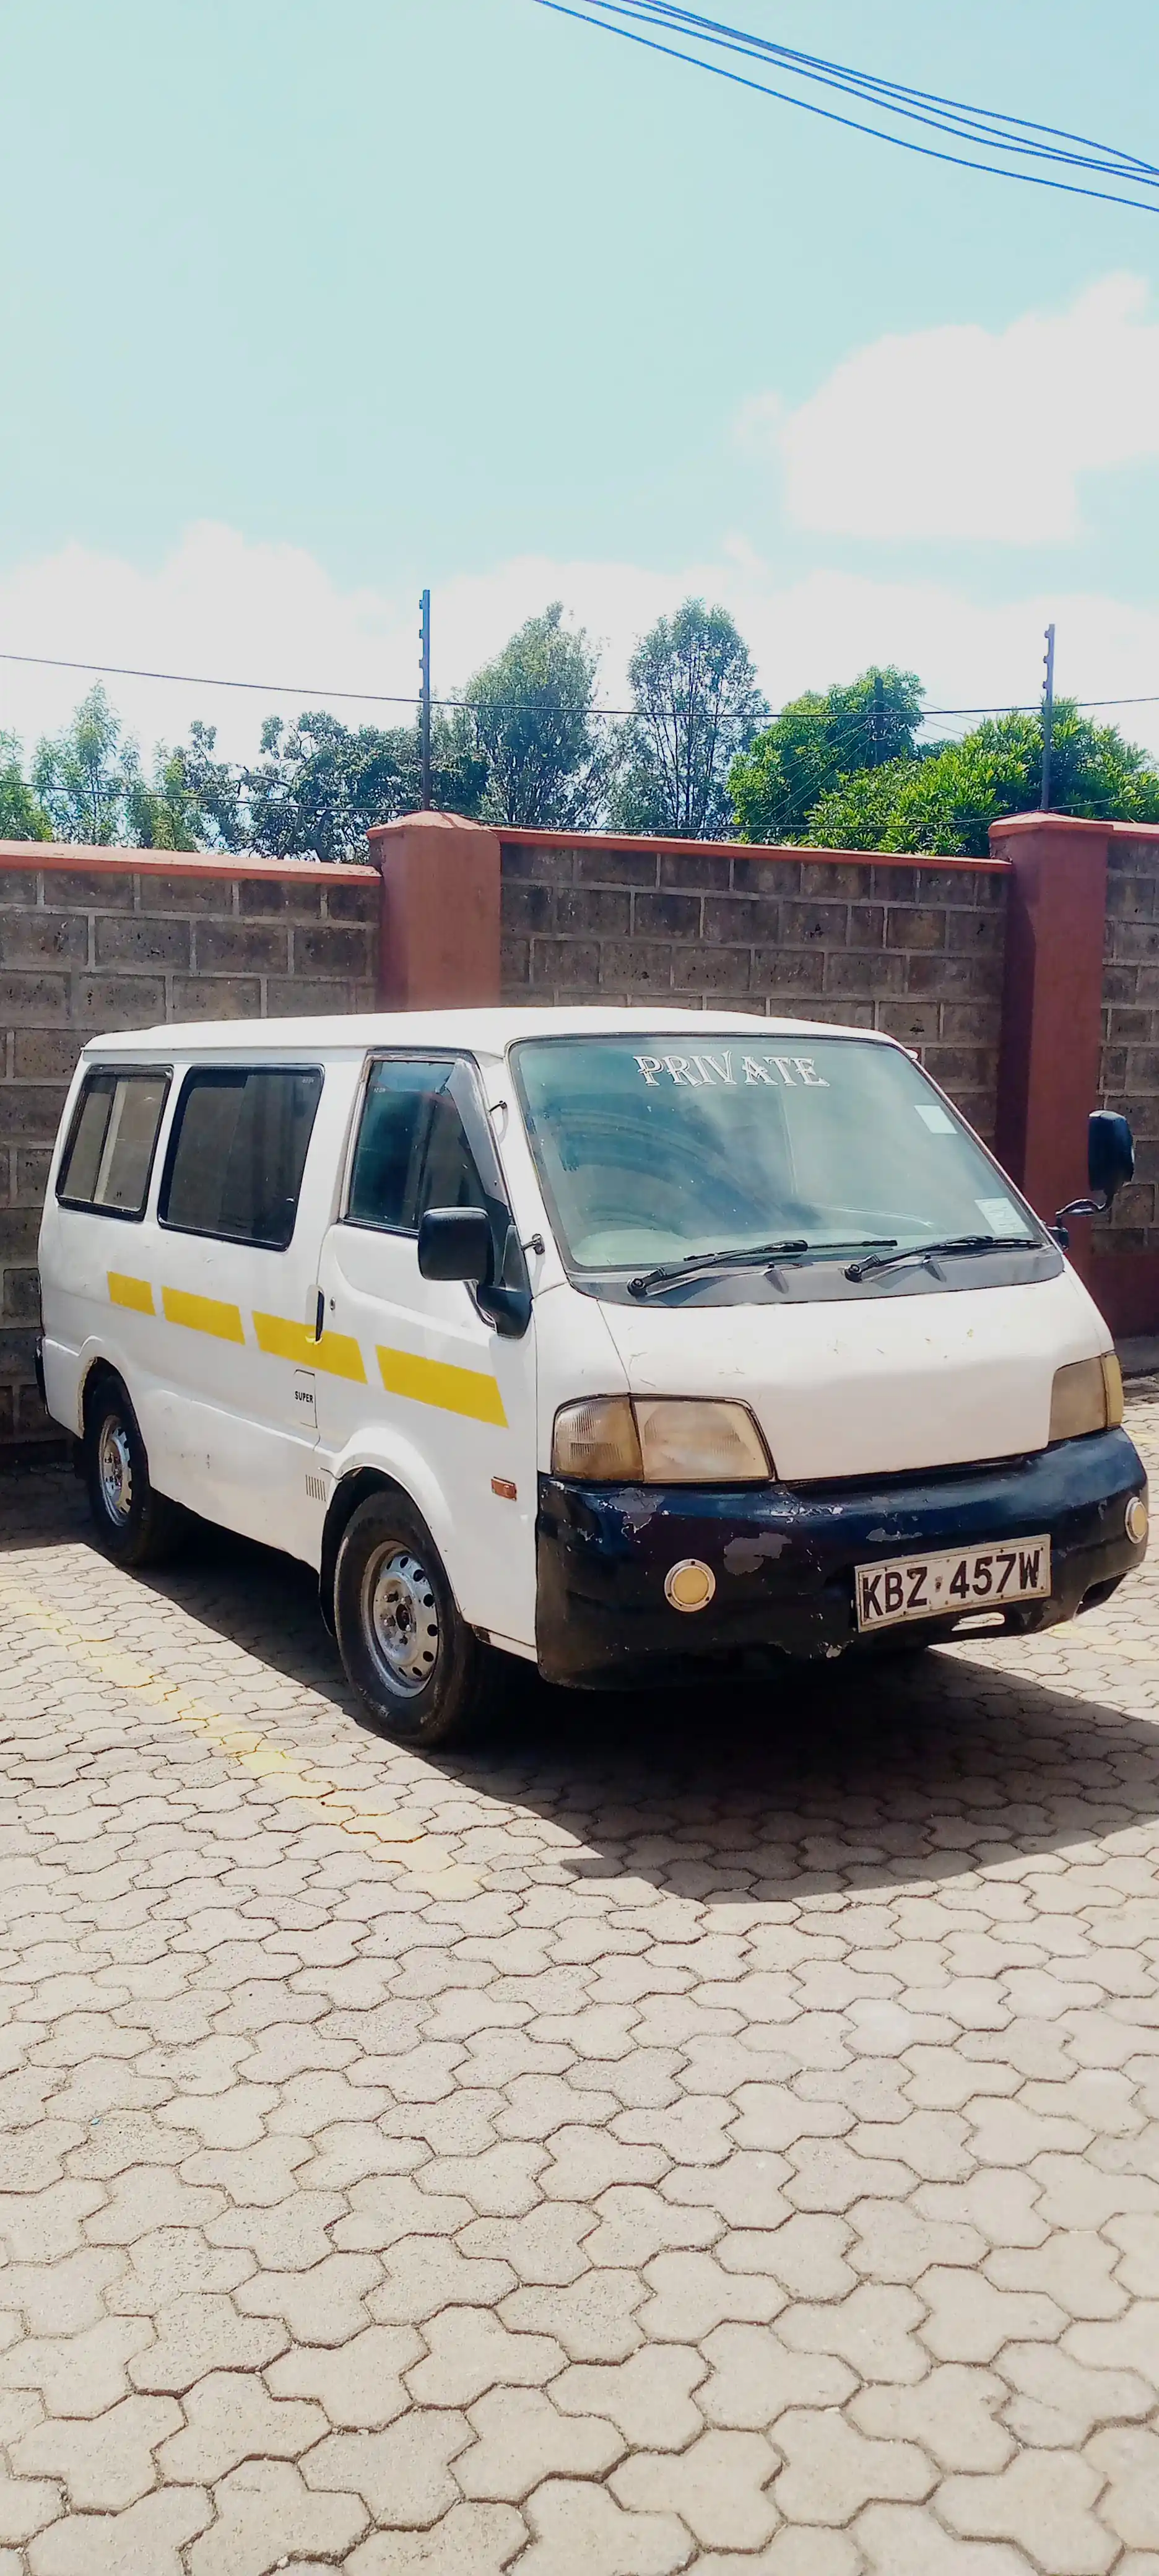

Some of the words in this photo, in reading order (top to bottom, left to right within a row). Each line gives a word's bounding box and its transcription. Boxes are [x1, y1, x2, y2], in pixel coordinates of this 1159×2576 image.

[633, 1050, 830, 1087] PRIVATE
[295, 1390, 313, 1403] SUPER
[862, 1566, 928, 1619] KBZ
[949, 1549, 1041, 1599] 457W
